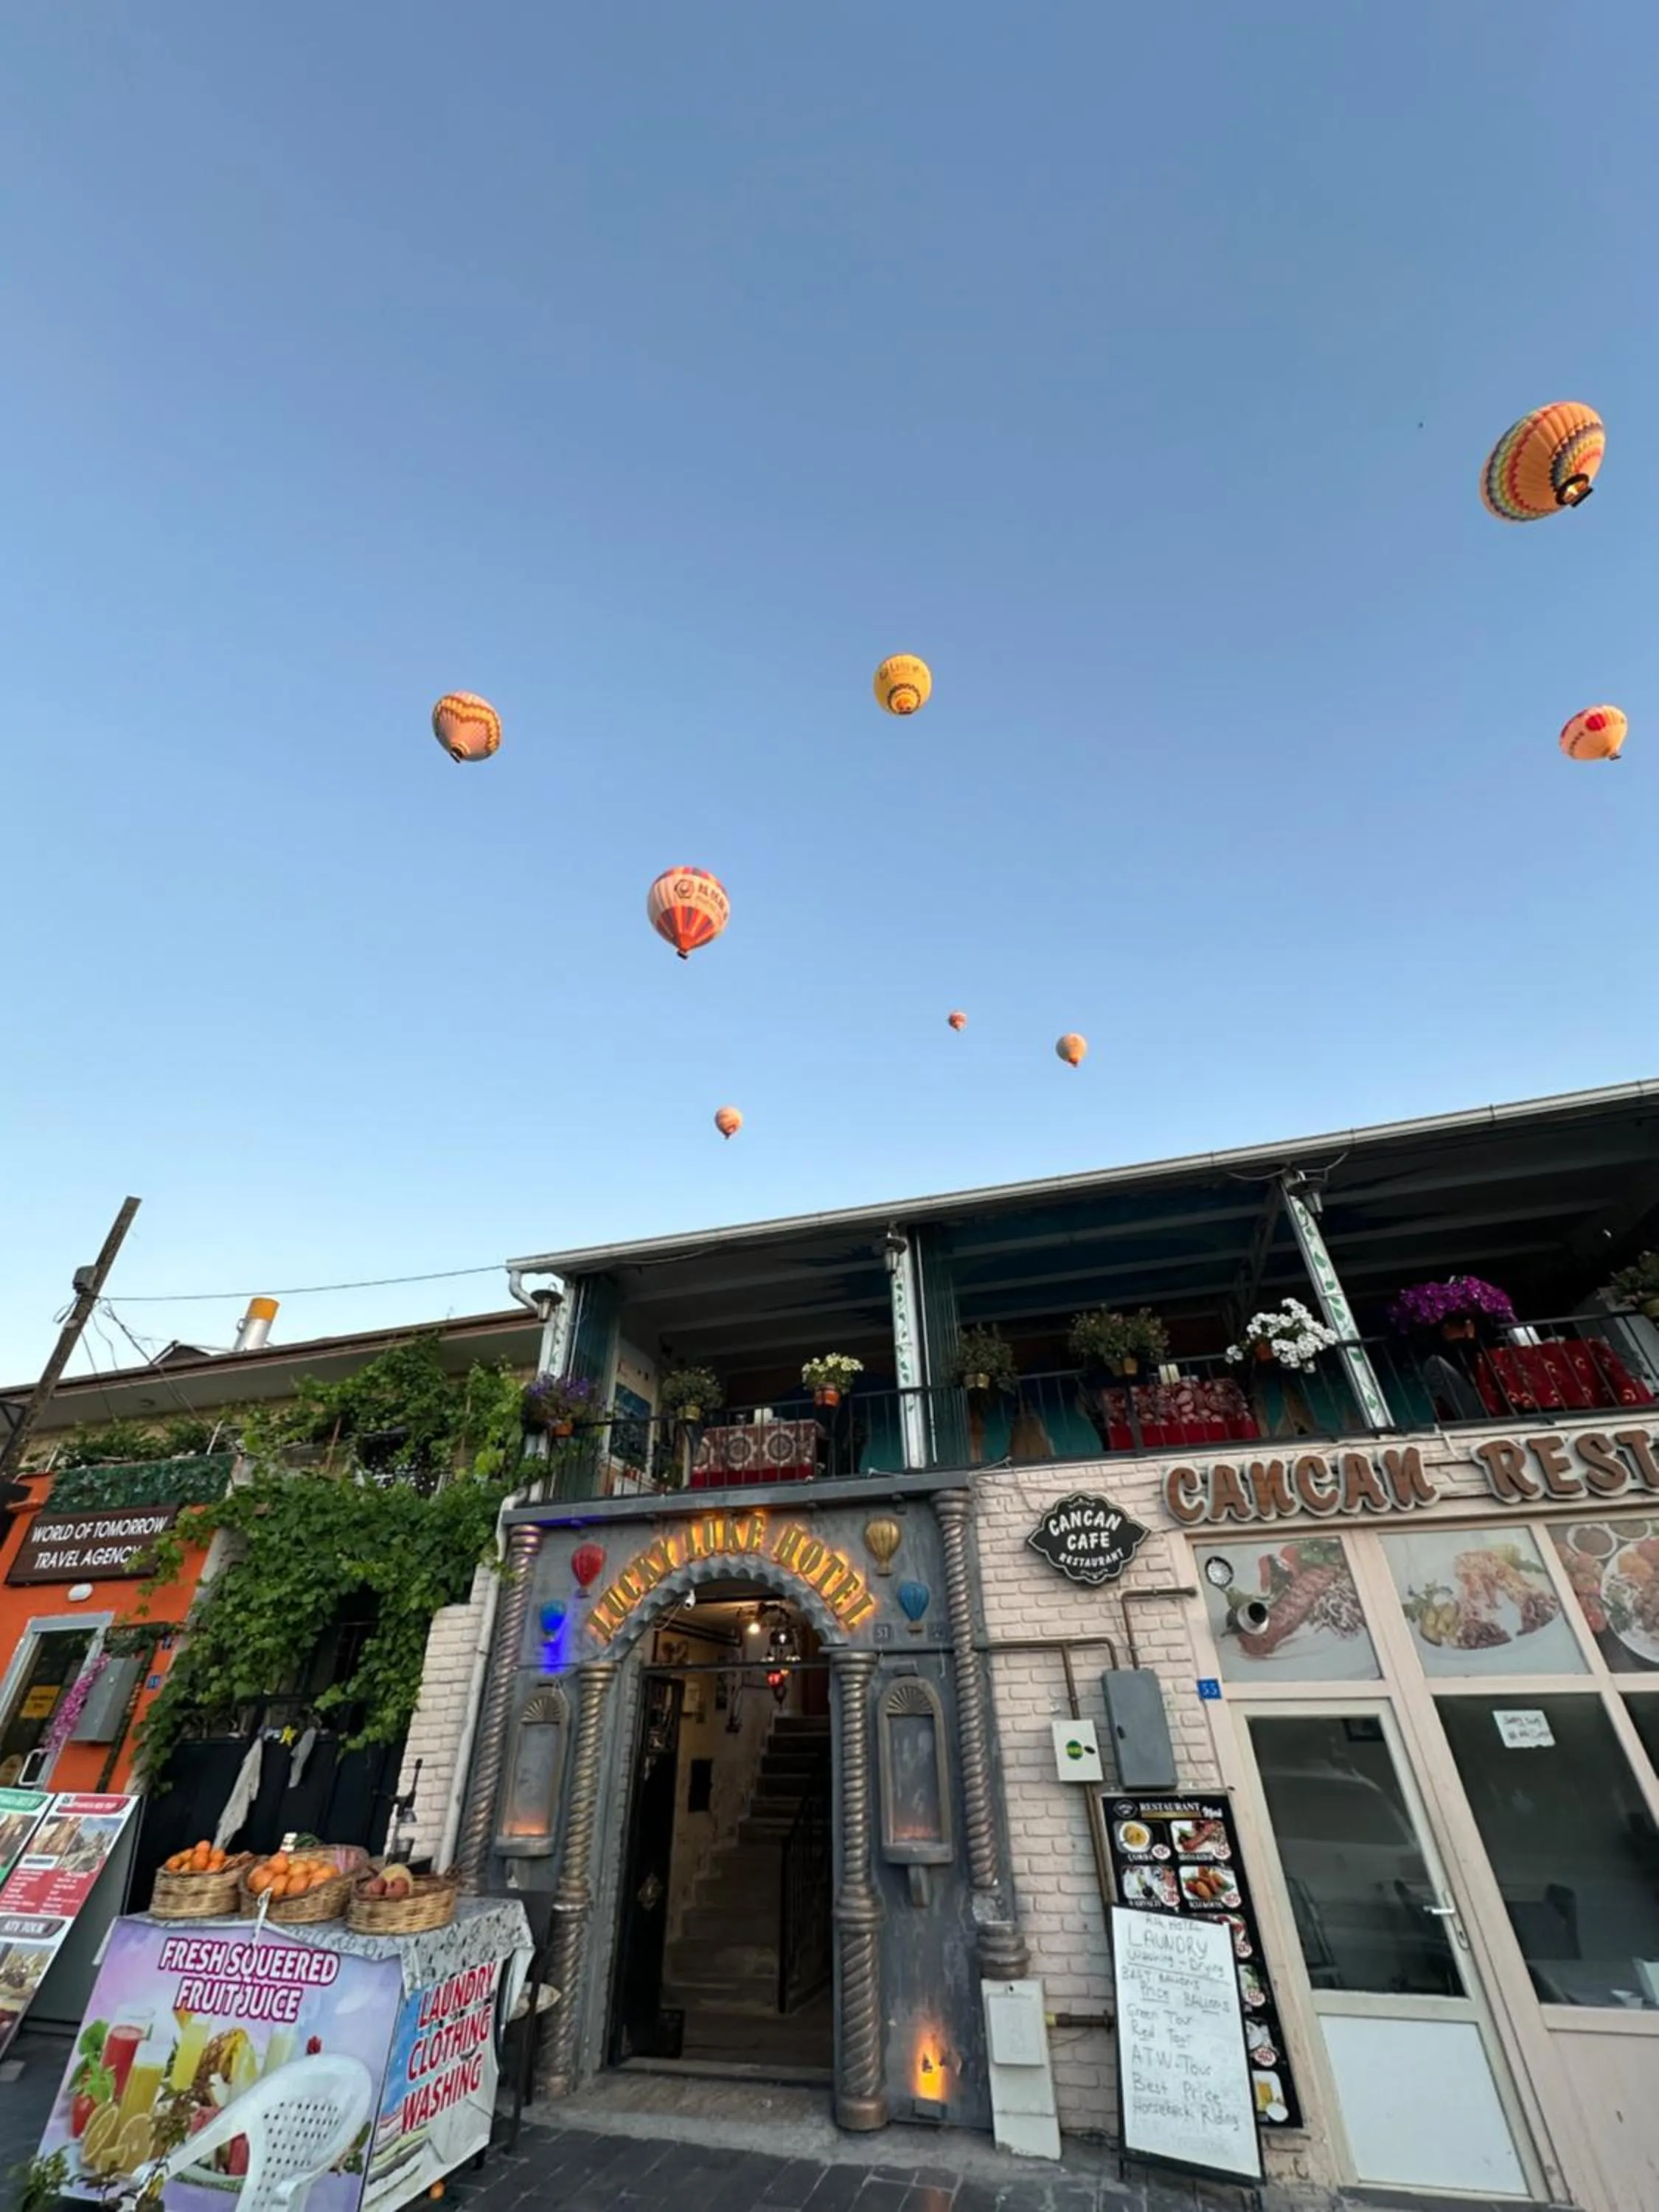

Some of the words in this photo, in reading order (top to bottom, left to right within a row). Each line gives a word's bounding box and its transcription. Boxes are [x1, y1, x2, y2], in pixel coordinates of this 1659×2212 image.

[1166, 1446, 1438, 1522] CANCAN
[32, 1523, 74, 1543] WORLD
[74, 1522, 94, 1540] OF
[93, 1516, 168, 1539] TOMORROW
[1048, 1509, 1121, 1537] CANCAN
[1067, 1531, 1110, 1551] CAFE
[34, 1549, 81, 1570] TRAVEL
[589, 1538, 675, 1643] LUCKY
[686, 1514, 764, 1561] LUKE
[773, 1523, 874, 1631] HOTEL
[1058, 1548, 1124, 1568] RESTAURANT
[1203, 1683, 1217, 1695] 55
[159, 1938, 226, 1975] FRESH
[228, 1944, 340, 1985] SQUEERED
[175, 1979, 237, 2014] FRUIT
[237, 1984, 303, 2023] JUICE
[418, 1961, 497, 2028] LAUNDRY
[406, 2008, 490, 2084] CLOTHING
[401, 2054, 483, 2134] WASHING
